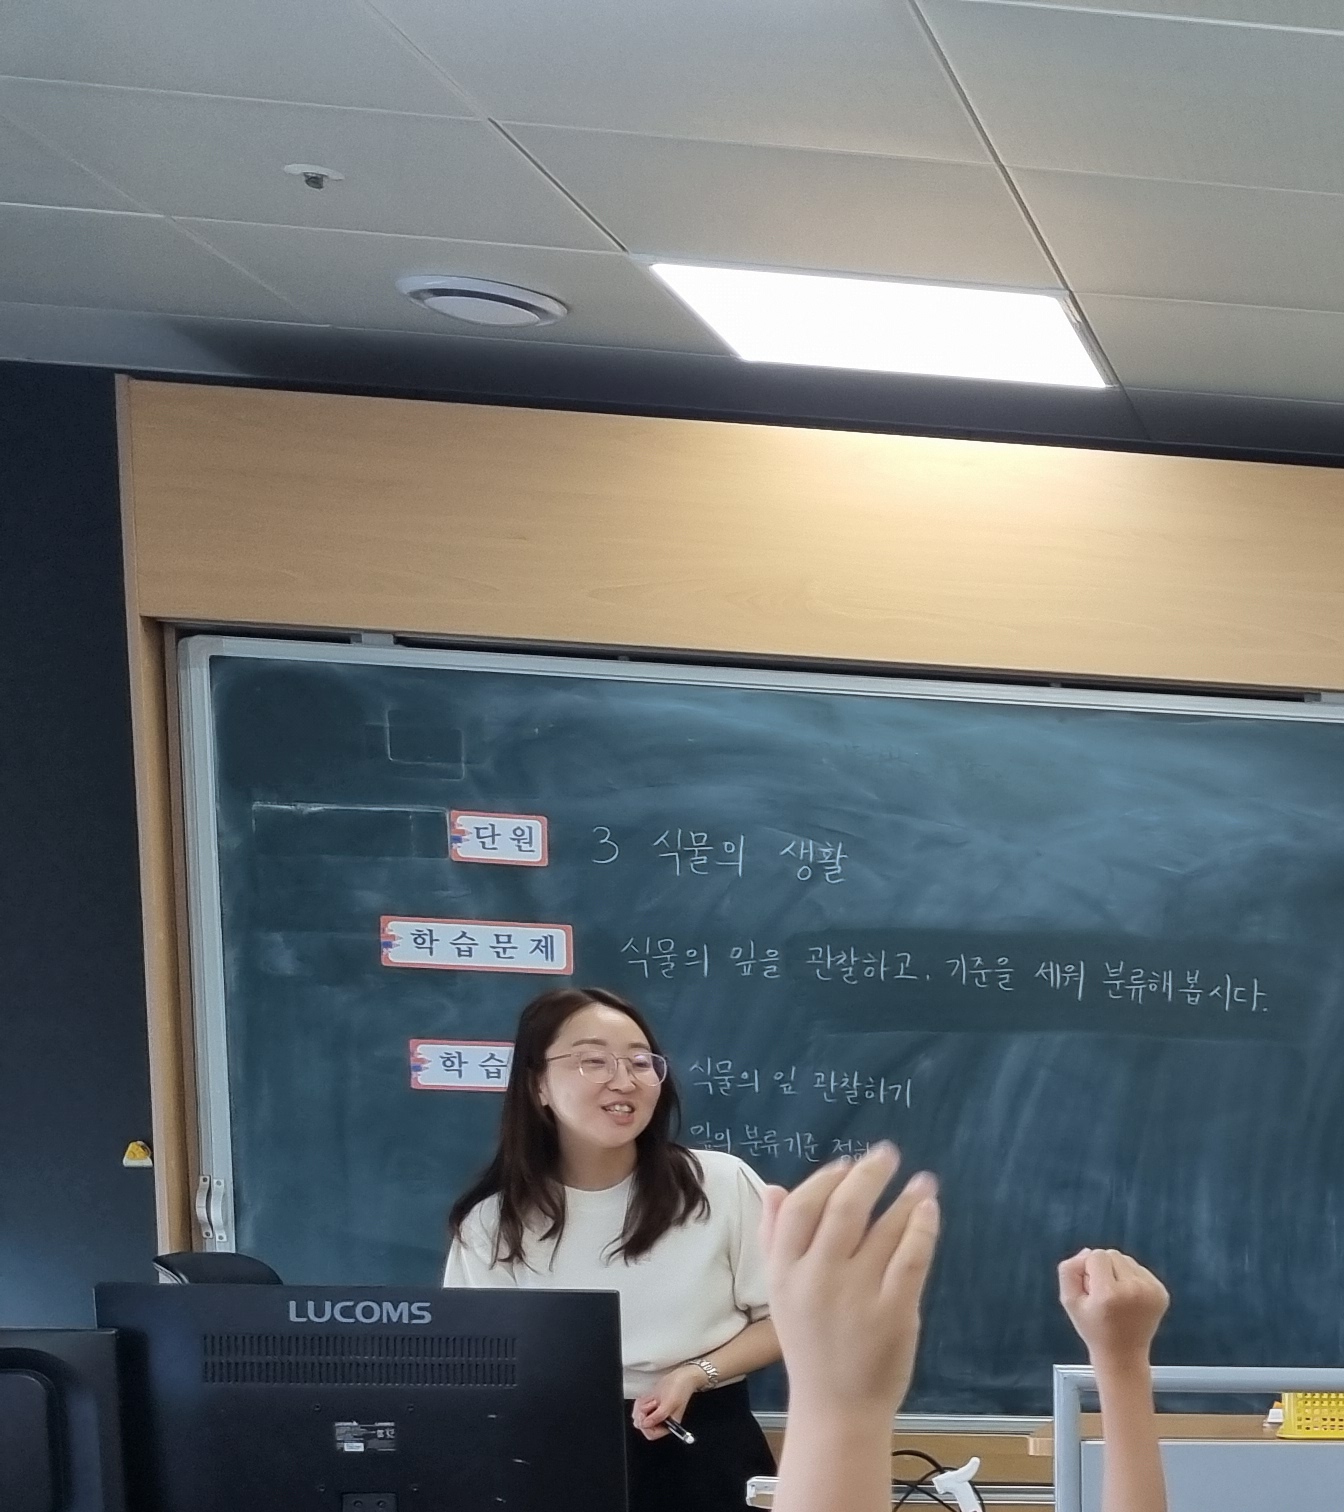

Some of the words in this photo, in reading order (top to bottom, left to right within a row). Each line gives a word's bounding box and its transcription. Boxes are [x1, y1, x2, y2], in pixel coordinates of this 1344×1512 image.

[473, 823, 536, 853] 단원
[592, 826, 619, 864] 3
[653, 828, 744, 877] 식물의
[780, 839, 848, 884] 생활
[410, 928, 556, 963] 학습문제
[621, 936, 708, 979] 식물의
[730, 941, 781, 979] 잎을
[946, 954, 1014, 991] 기준을
[1035, 961, 1085, 1002] 세워
[440, 1051, 507, 1080] 학습
[690, 1057, 759, 1096] 식물의
[773, 1066, 797, 1094] 잎
[813, 1070, 912, 1108] 관찰하기
[288, 1300, 432, 1325] LUCOMS
